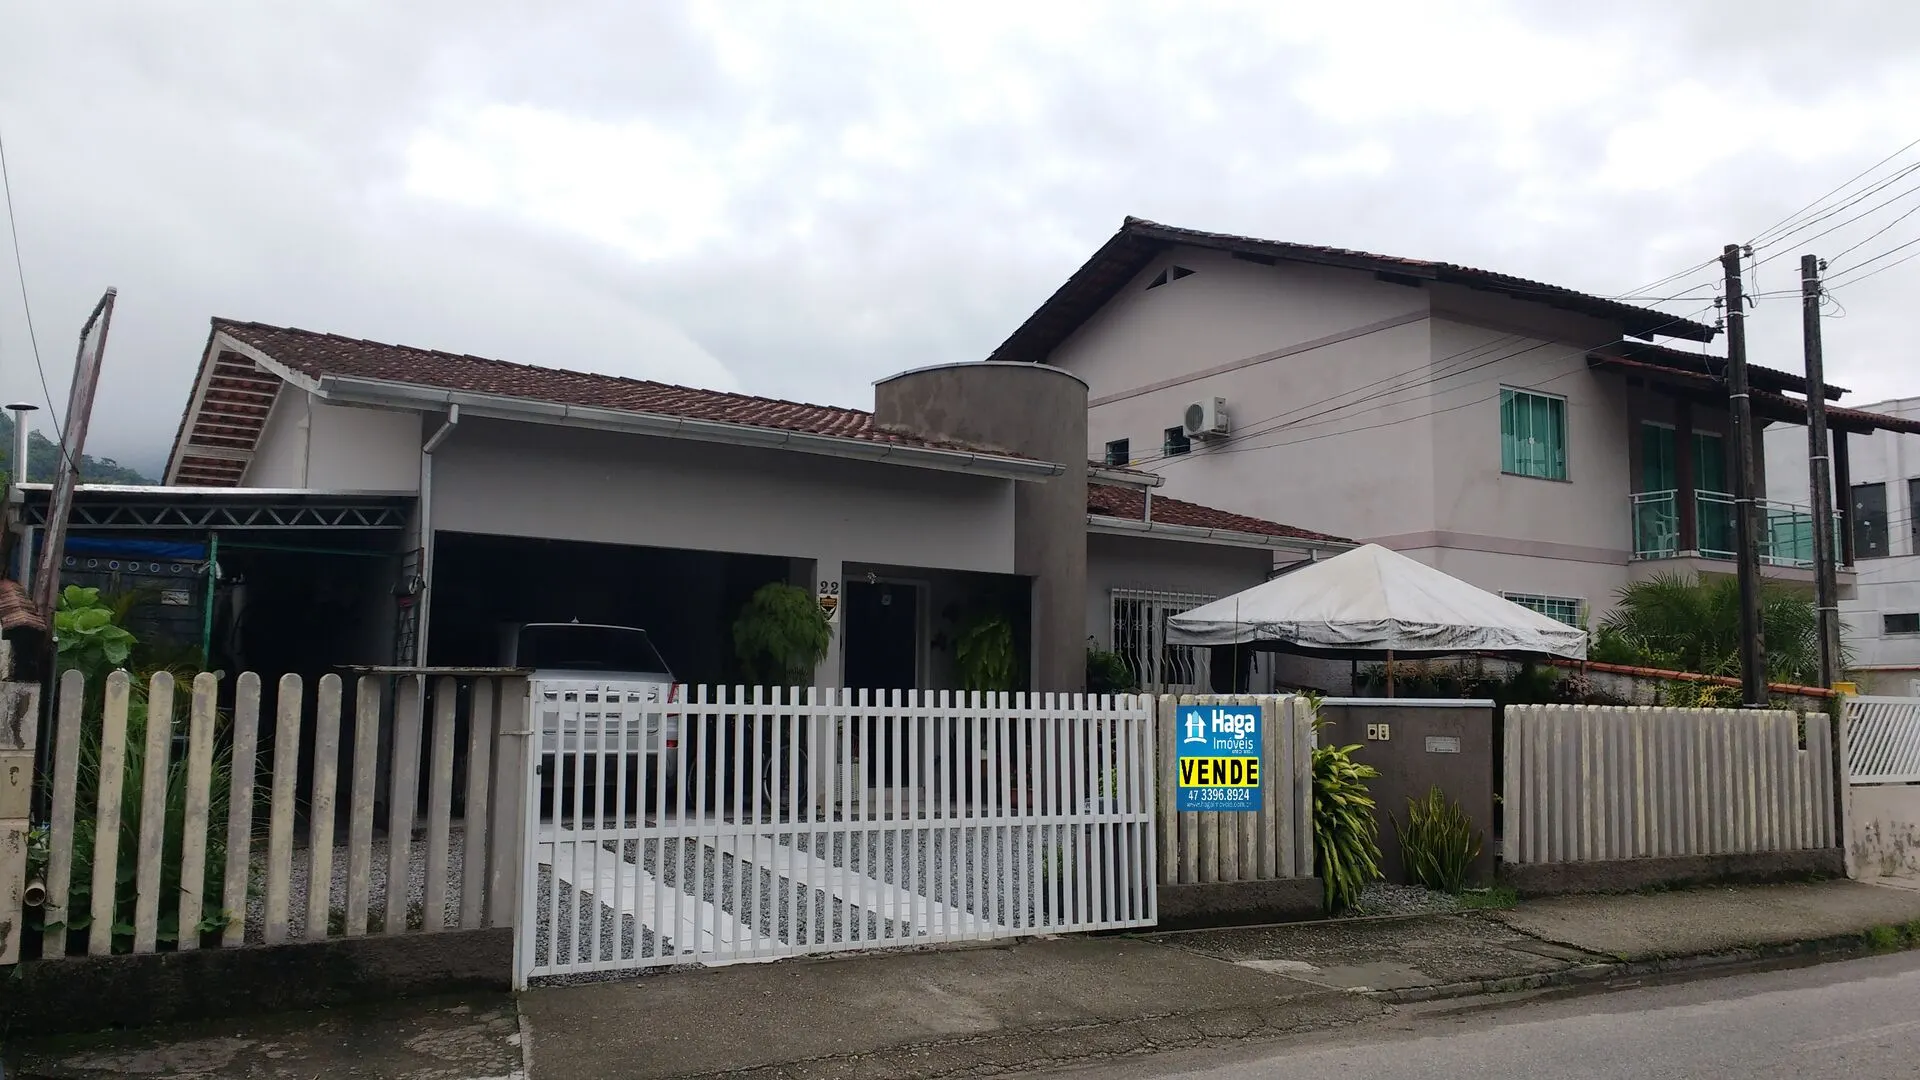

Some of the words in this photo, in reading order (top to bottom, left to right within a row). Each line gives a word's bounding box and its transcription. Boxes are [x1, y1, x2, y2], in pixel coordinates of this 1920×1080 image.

[820, 580, 839, 595] 22
[1212, 709, 1255, 739] Haga
[1213, 737, 1254, 750] Imóveis
[1180, 759, 1258, 784] VENDE
[1188, 790, 1199, 801] 47
[1201, 788, 1250, 801] 3396.8924
